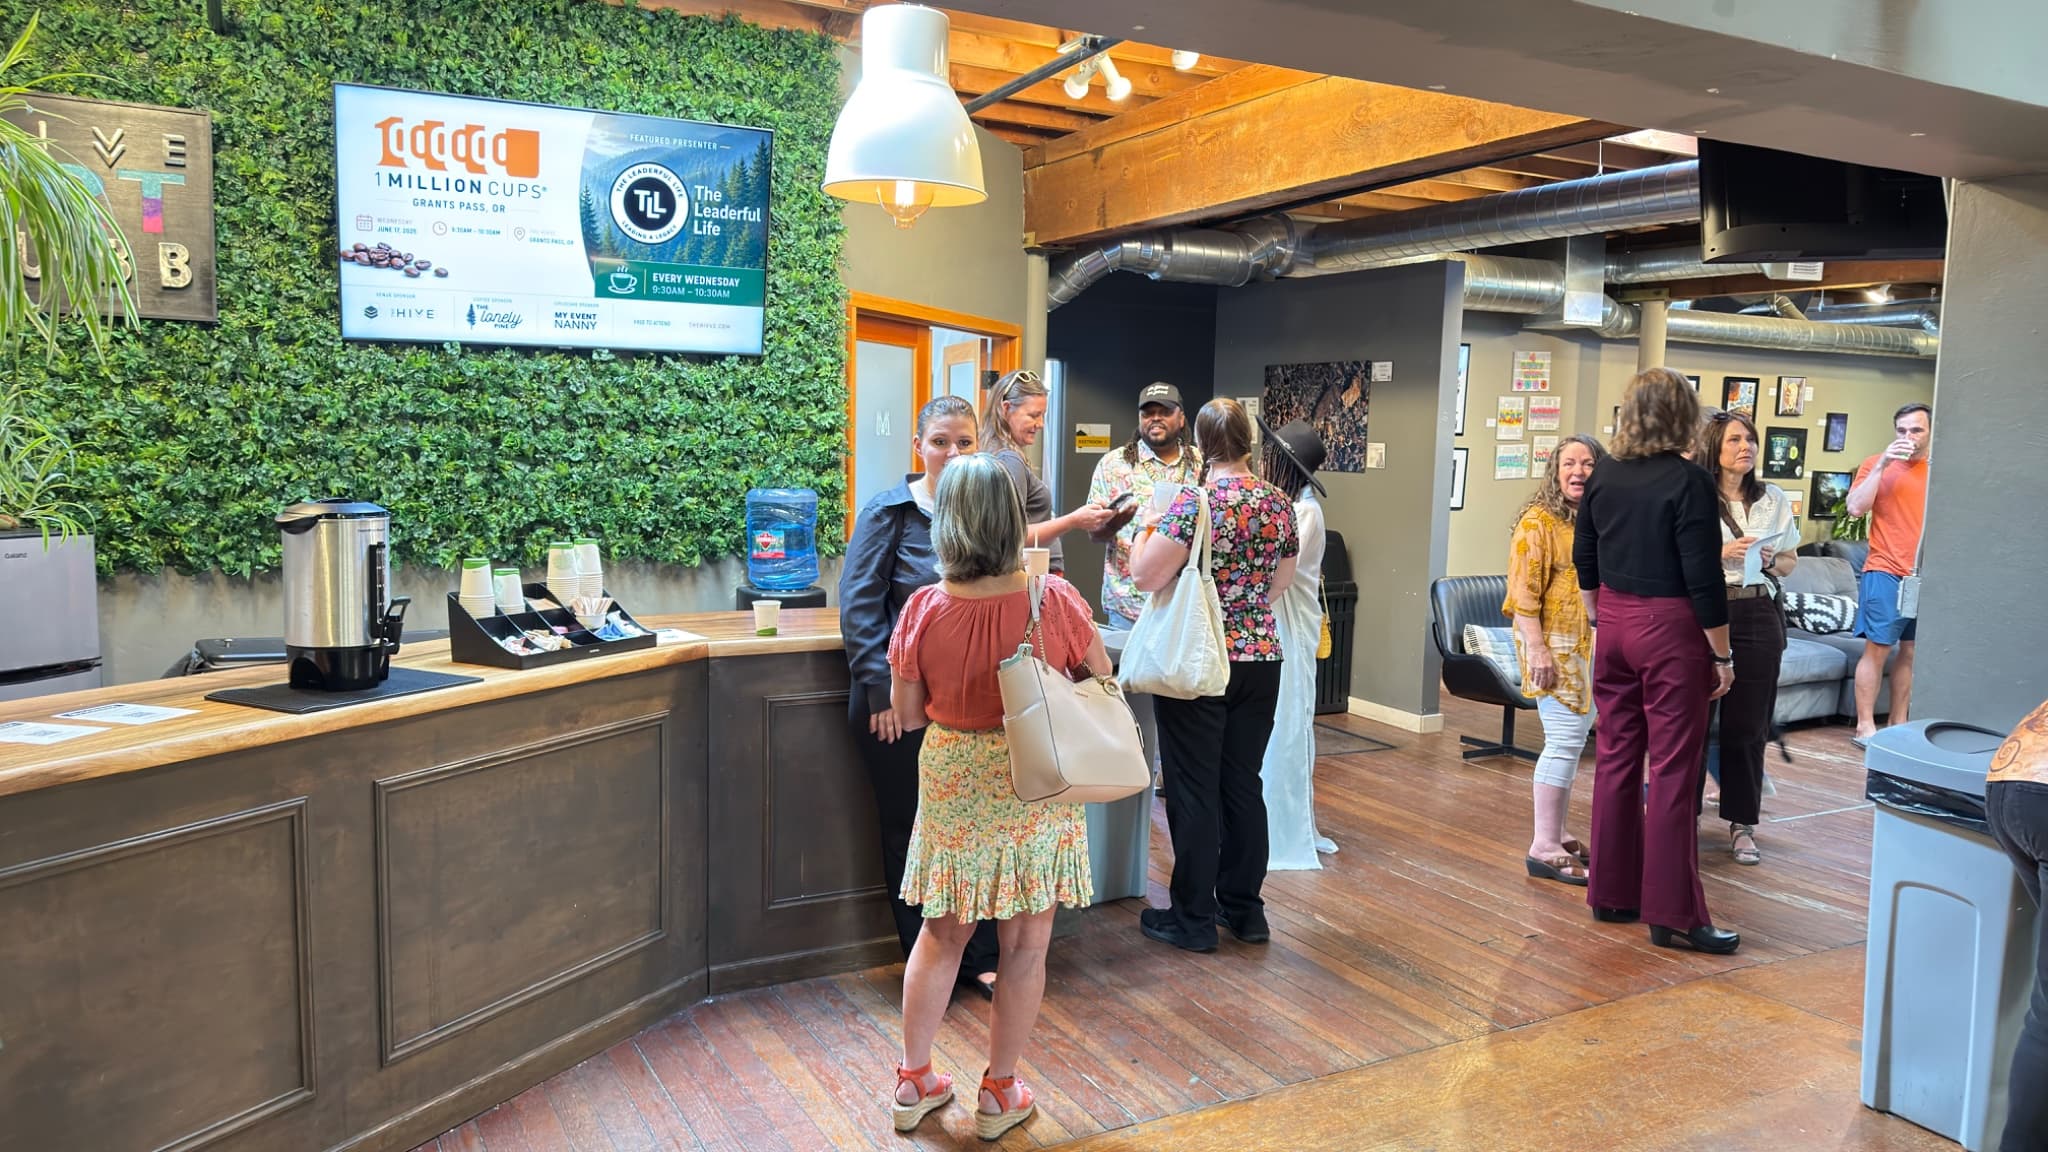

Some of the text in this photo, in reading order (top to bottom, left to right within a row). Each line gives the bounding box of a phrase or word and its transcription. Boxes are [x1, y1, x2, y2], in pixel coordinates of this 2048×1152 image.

[38, 119, 187, 168] IVE
[630, 134, 718, 150] FEATURED PRESENTER
[374, 171, 382, 187] 1
[388, 172, 482, 194] MILLION
[616, 167, 684, 199] THE LEADERFUL LIFE
[694, 185, 722, 202] The
[412, 198, 506, 214] GRANTS PASS, OR
[633, 189, 668, 219] TLL
[694, 202, 761, 222] Leaderful
[621, 219, 648, 240] LEADING
[655, 224, 678, 240] LEGACY
[693, 220, 721, 236] Life
[652, 272, 740, 287] EVERY WEDNESDAY
[652, 285, 685, 296] 9:30AM
[695, 287, 731, 298] 10:30AM
[396, 309, 435, 319] HIVE
[480, 310, 523, 329] lonely
[554, 311, 597, 320] MY EVENT
[554, 319, 597, 330] NANNY
